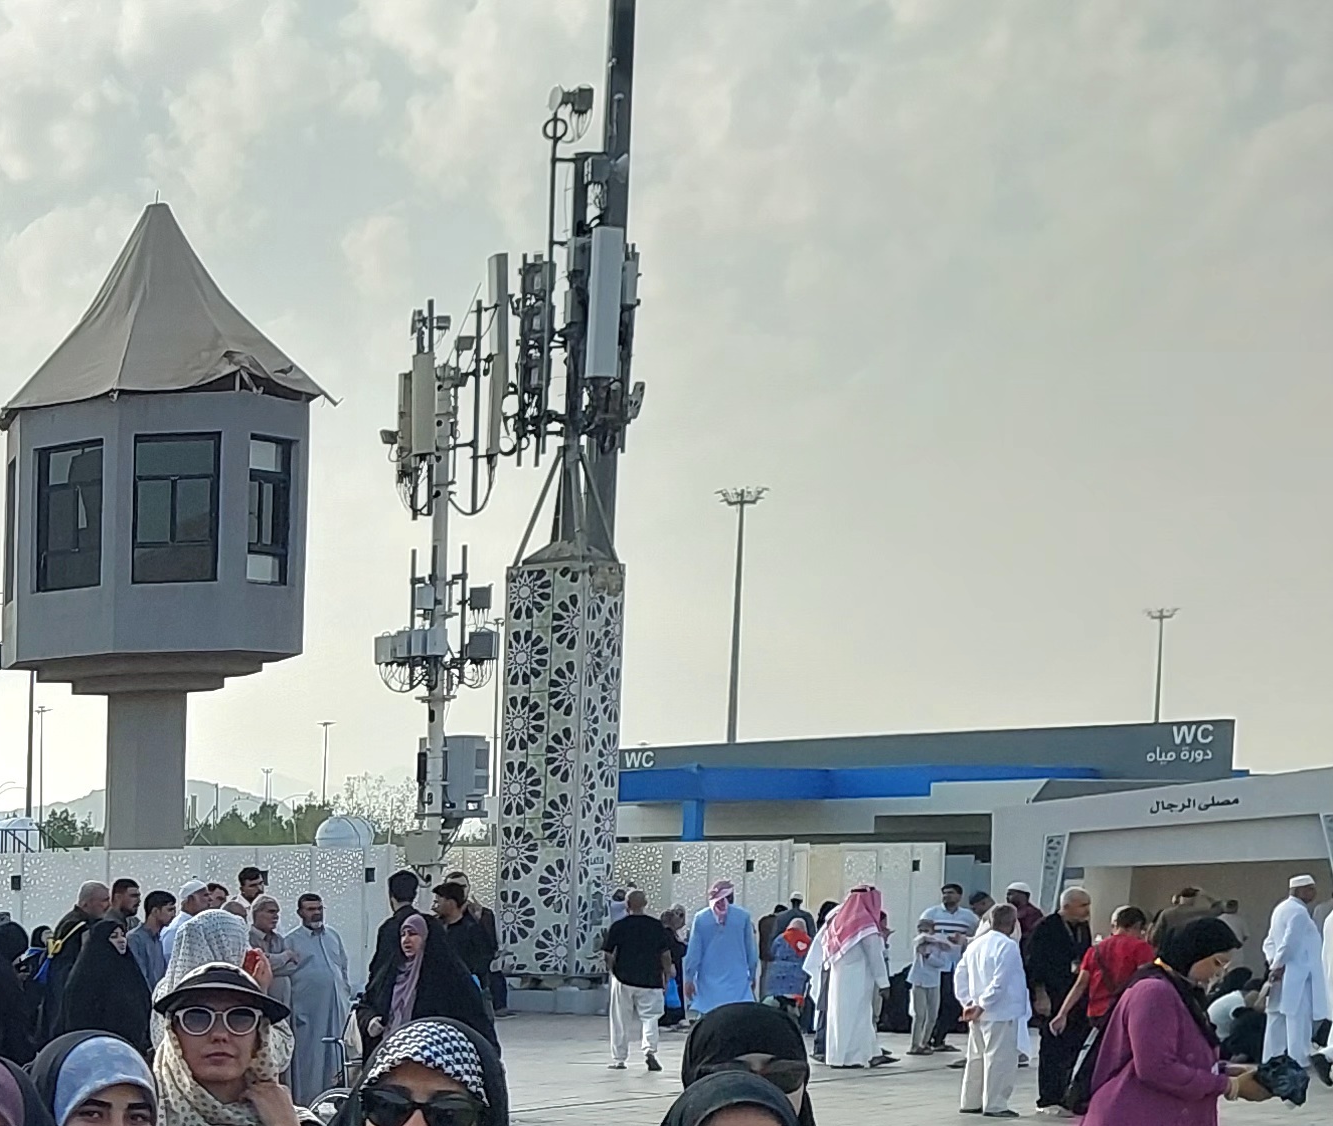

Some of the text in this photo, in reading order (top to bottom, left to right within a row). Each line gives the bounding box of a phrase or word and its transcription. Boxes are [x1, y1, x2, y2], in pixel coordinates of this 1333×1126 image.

[1172, 724, 1214, 745] WC
[624, 750, 655, 768] WC
[1146, 746, 1212, 765] دورة مياه
[1149, 795, 1240, 814] مصلى الرجال
